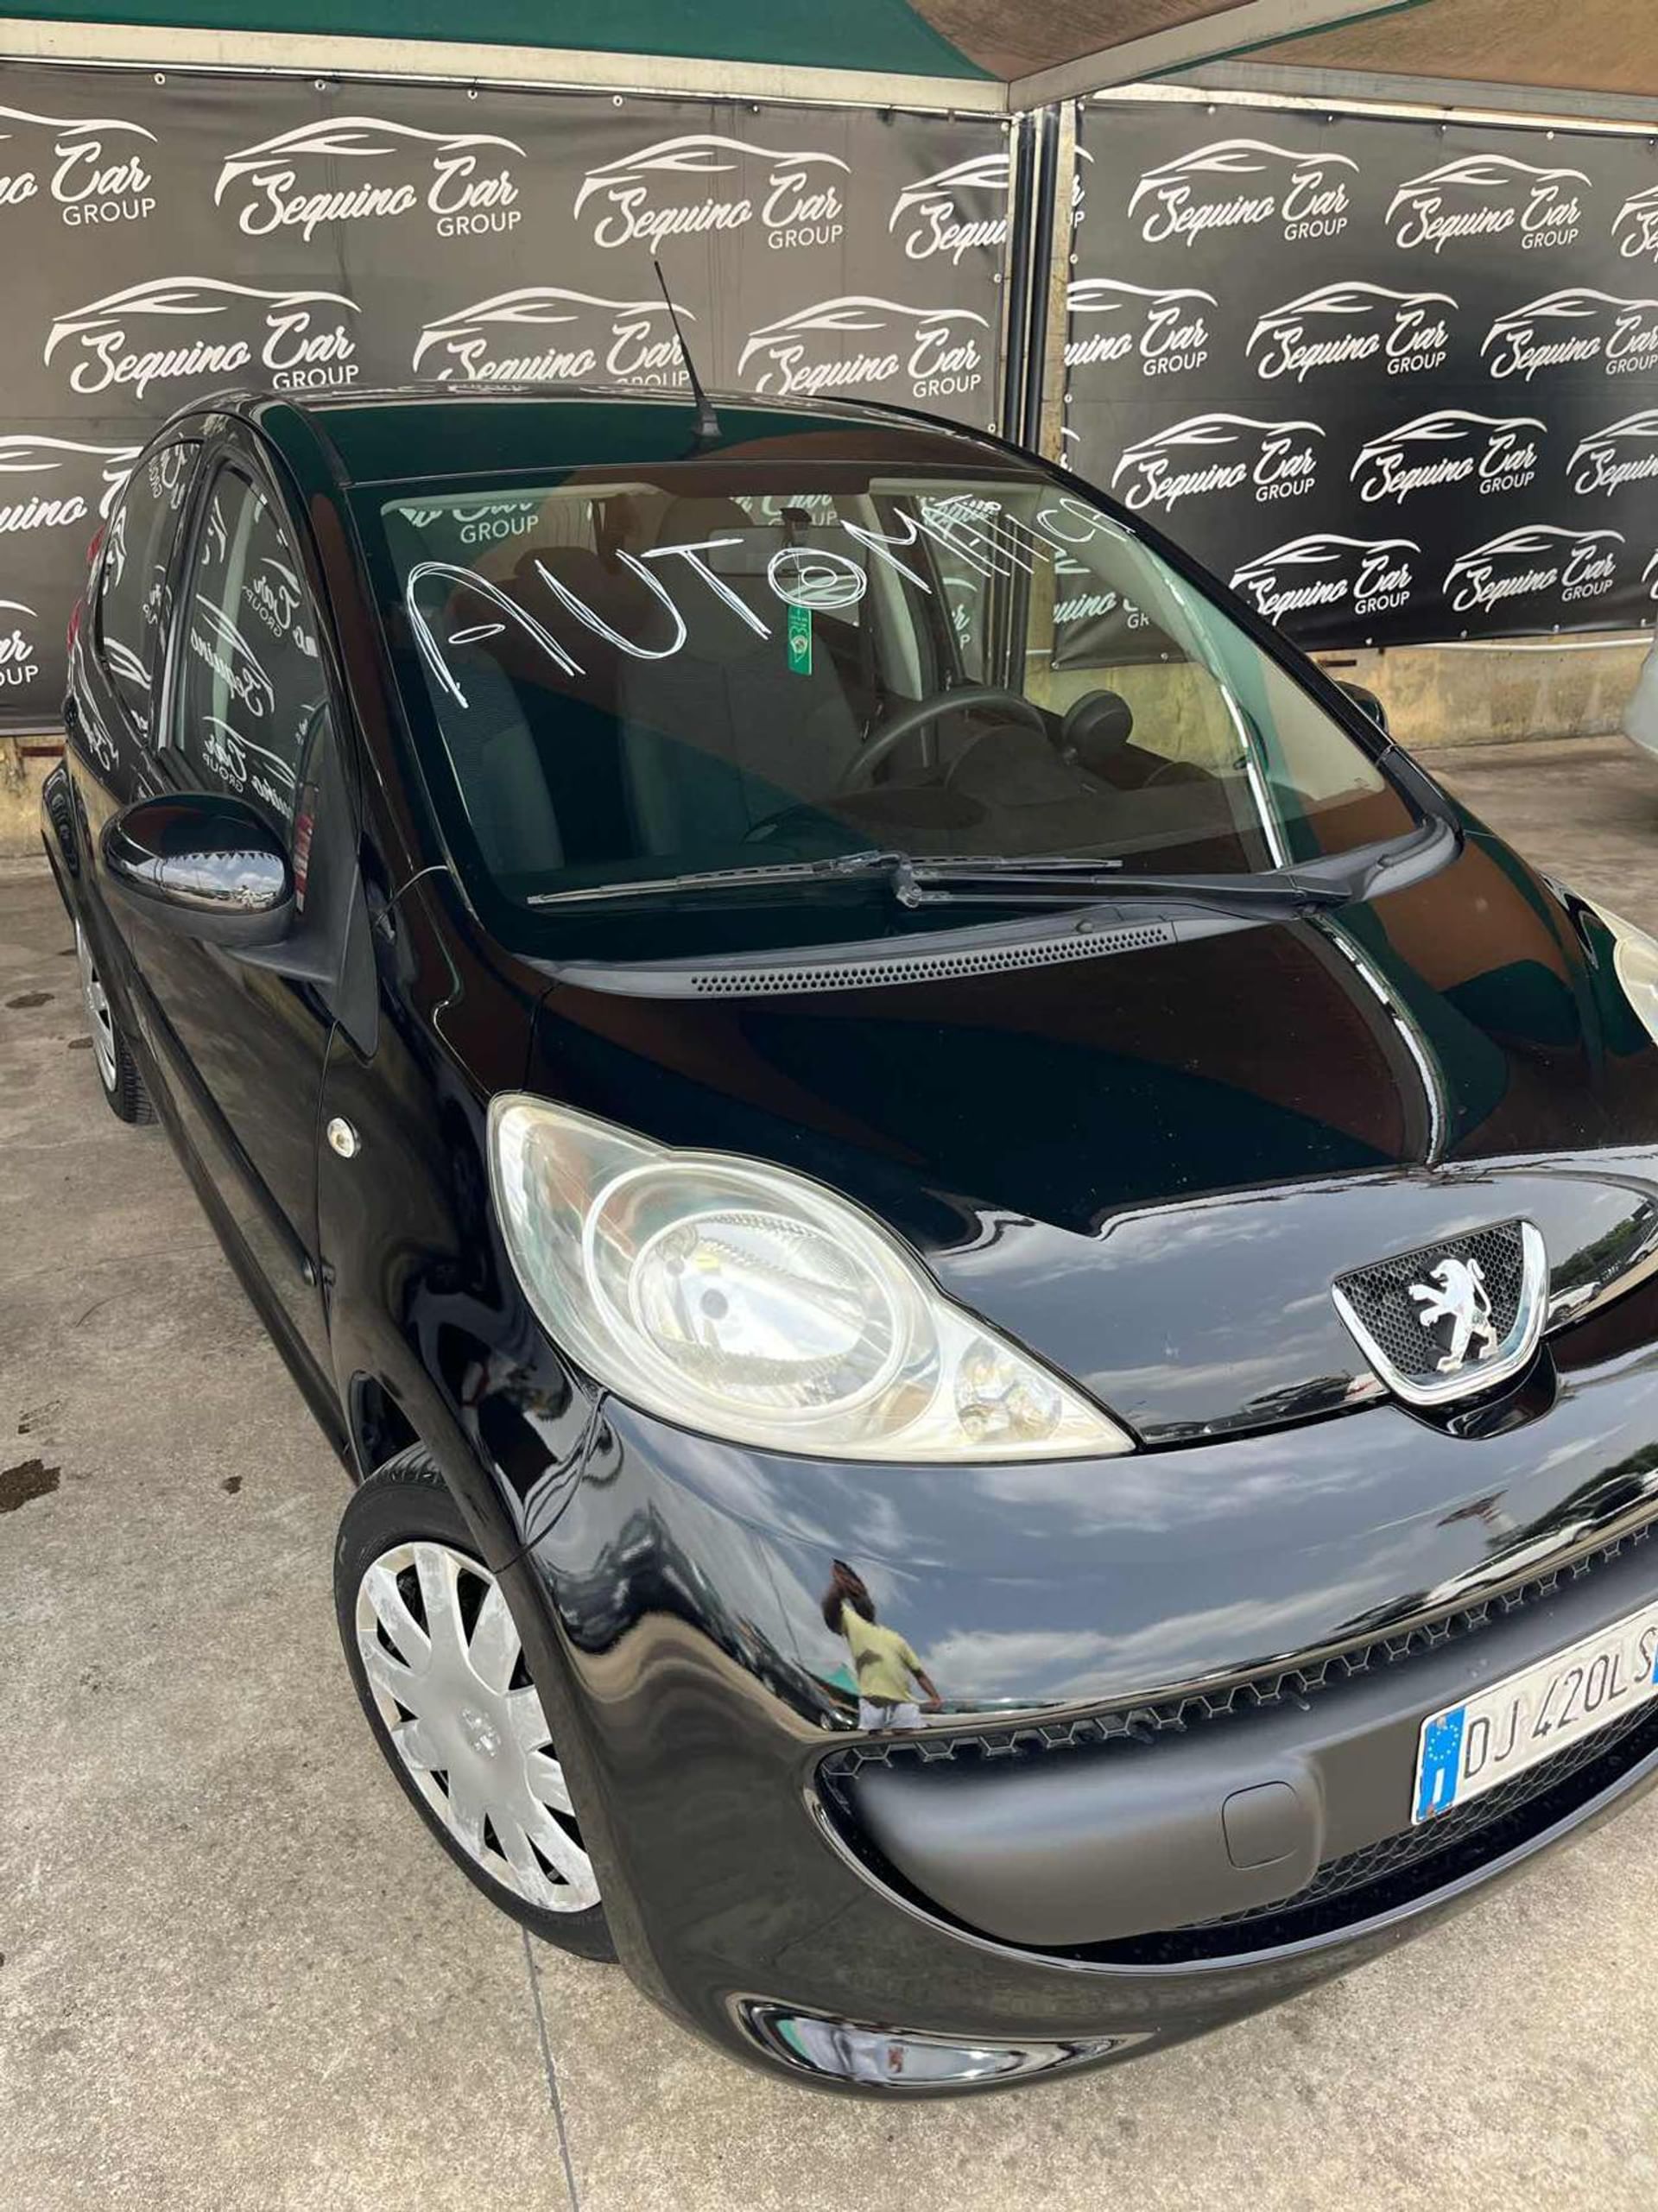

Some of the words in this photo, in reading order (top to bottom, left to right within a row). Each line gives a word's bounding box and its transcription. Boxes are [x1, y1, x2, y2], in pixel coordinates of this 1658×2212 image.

[51, 142, 151, 202] Car
[63, 198, 156, 225] GROUP
[239, 171, 416, 241] Sequino
[428, 156, 518, 213] Car
[594, 187, 752, 254] Sequino
[763, 173, 842, 227] Car
[1142, 186, 1275, 246] Sequino
[1281, 171, 1349, 221] Car
[437, 212, 521, 236] GROUP
[1284, 218, 1348, 240] GROUP
[1396, 197, 1515, 253] Sequino
[1521, 186, 1581, 231] Car
[769, 225, 842, 249] GROUP
[1522, 229, 1579, 249] GROUP
[1140, 307, 1208, 357] Car
[1258, 326, 1380, 383] Sequino
[1386, 309, 1448, 357] Car
[70, 331, 250, 399] Sequino
[262, 312, 355, 369] Car
[756, 345, 899, 396] Sequino
[908, 328, 980, 378] Car
[1143, 352, 1207, 376] GROUP
[1387, 352, 1446, 374] GROUP
[1490, 329, 1600, 382] Sequino
[1606, 354, 1658, 374] GROUP
[273, 364, 358, 391] GROUP
[913, 374, 981, 397] GROUP
[1125, 459, 1247, 512] Sequino
[1253, 438, 1316, 485] Car
[1361, 453, 1473, 504] Sequino
[1478, 434, 1537, 478] Car
[1479, 472, 1535, 494] GROUP
[1256, 478, 1315, 502] GROUP
[0, 497, 87, 533] uino
[461, 516, 539, 543] GROUP
[1353, 555, 1412, 599] Car
[1452, 566, 1558, 612] Sequino
[1561, 545, 1616, 586] Car
[1562, 580, 1613, 601] GROUP
[1355, 591, 1410, 614] GROUP
